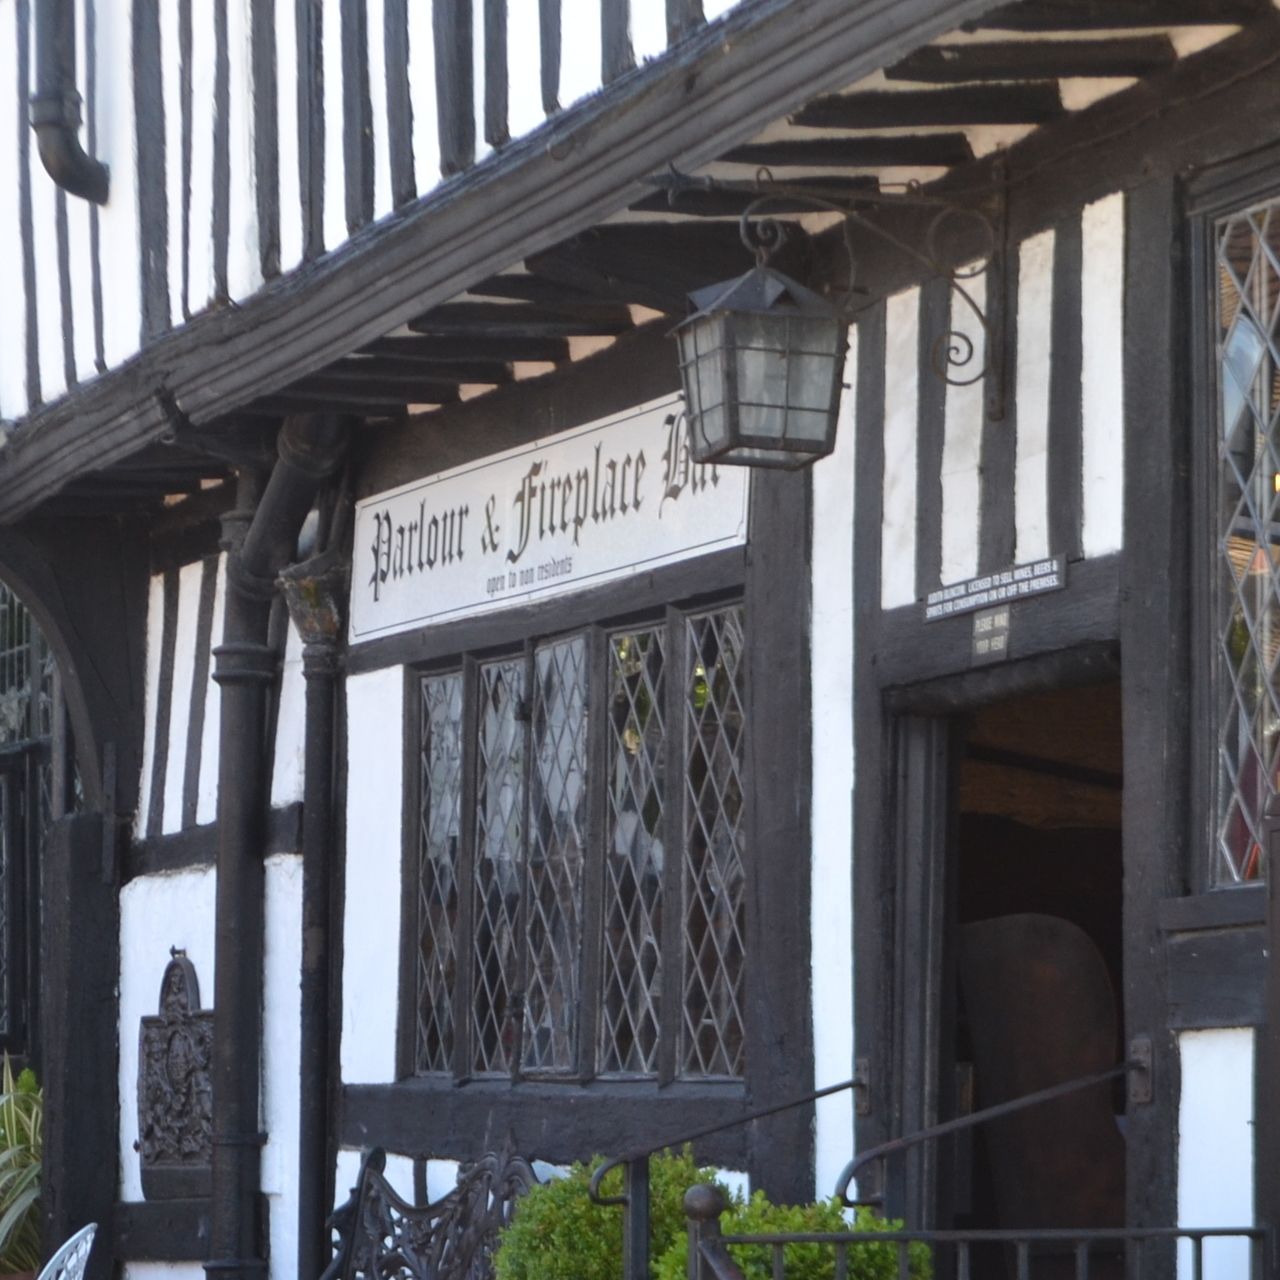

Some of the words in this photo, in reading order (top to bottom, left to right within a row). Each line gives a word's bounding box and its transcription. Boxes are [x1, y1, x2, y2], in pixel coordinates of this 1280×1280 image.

[368, 498, 470, 602] Parlour
[481, 493, 500, 555] &
[505, 441, 647, 564] Fireplace
[486, 574, 506, 598] open
[508, 570, 517, 589] to
[537, 556, 573, 581] residents
